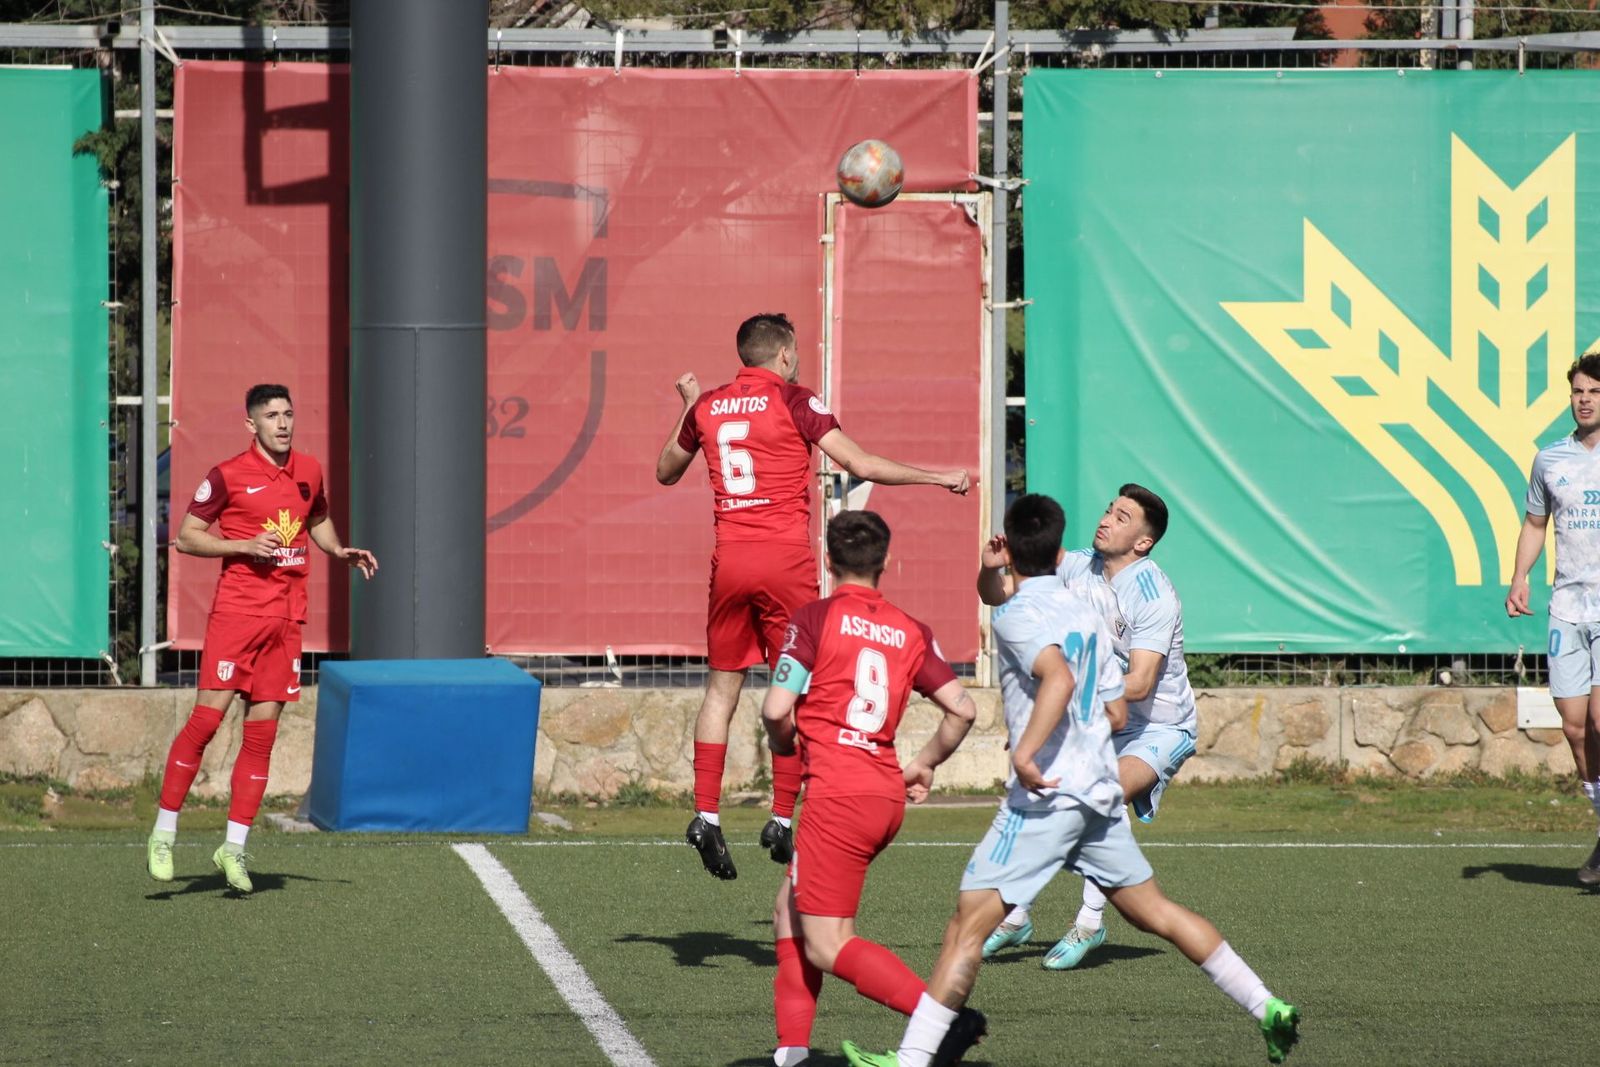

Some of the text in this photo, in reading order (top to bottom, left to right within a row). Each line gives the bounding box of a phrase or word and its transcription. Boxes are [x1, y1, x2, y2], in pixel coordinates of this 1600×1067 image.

[710, 395, 769, 416] SANTOS
[717, 421, 756, 496] 6
[1567, 508, 1600, 517] MIRA
[840, 614, 906, 648] ASENSIO
[776, 662, 792, 682] 8
[846, 647, 889, 734] 8
